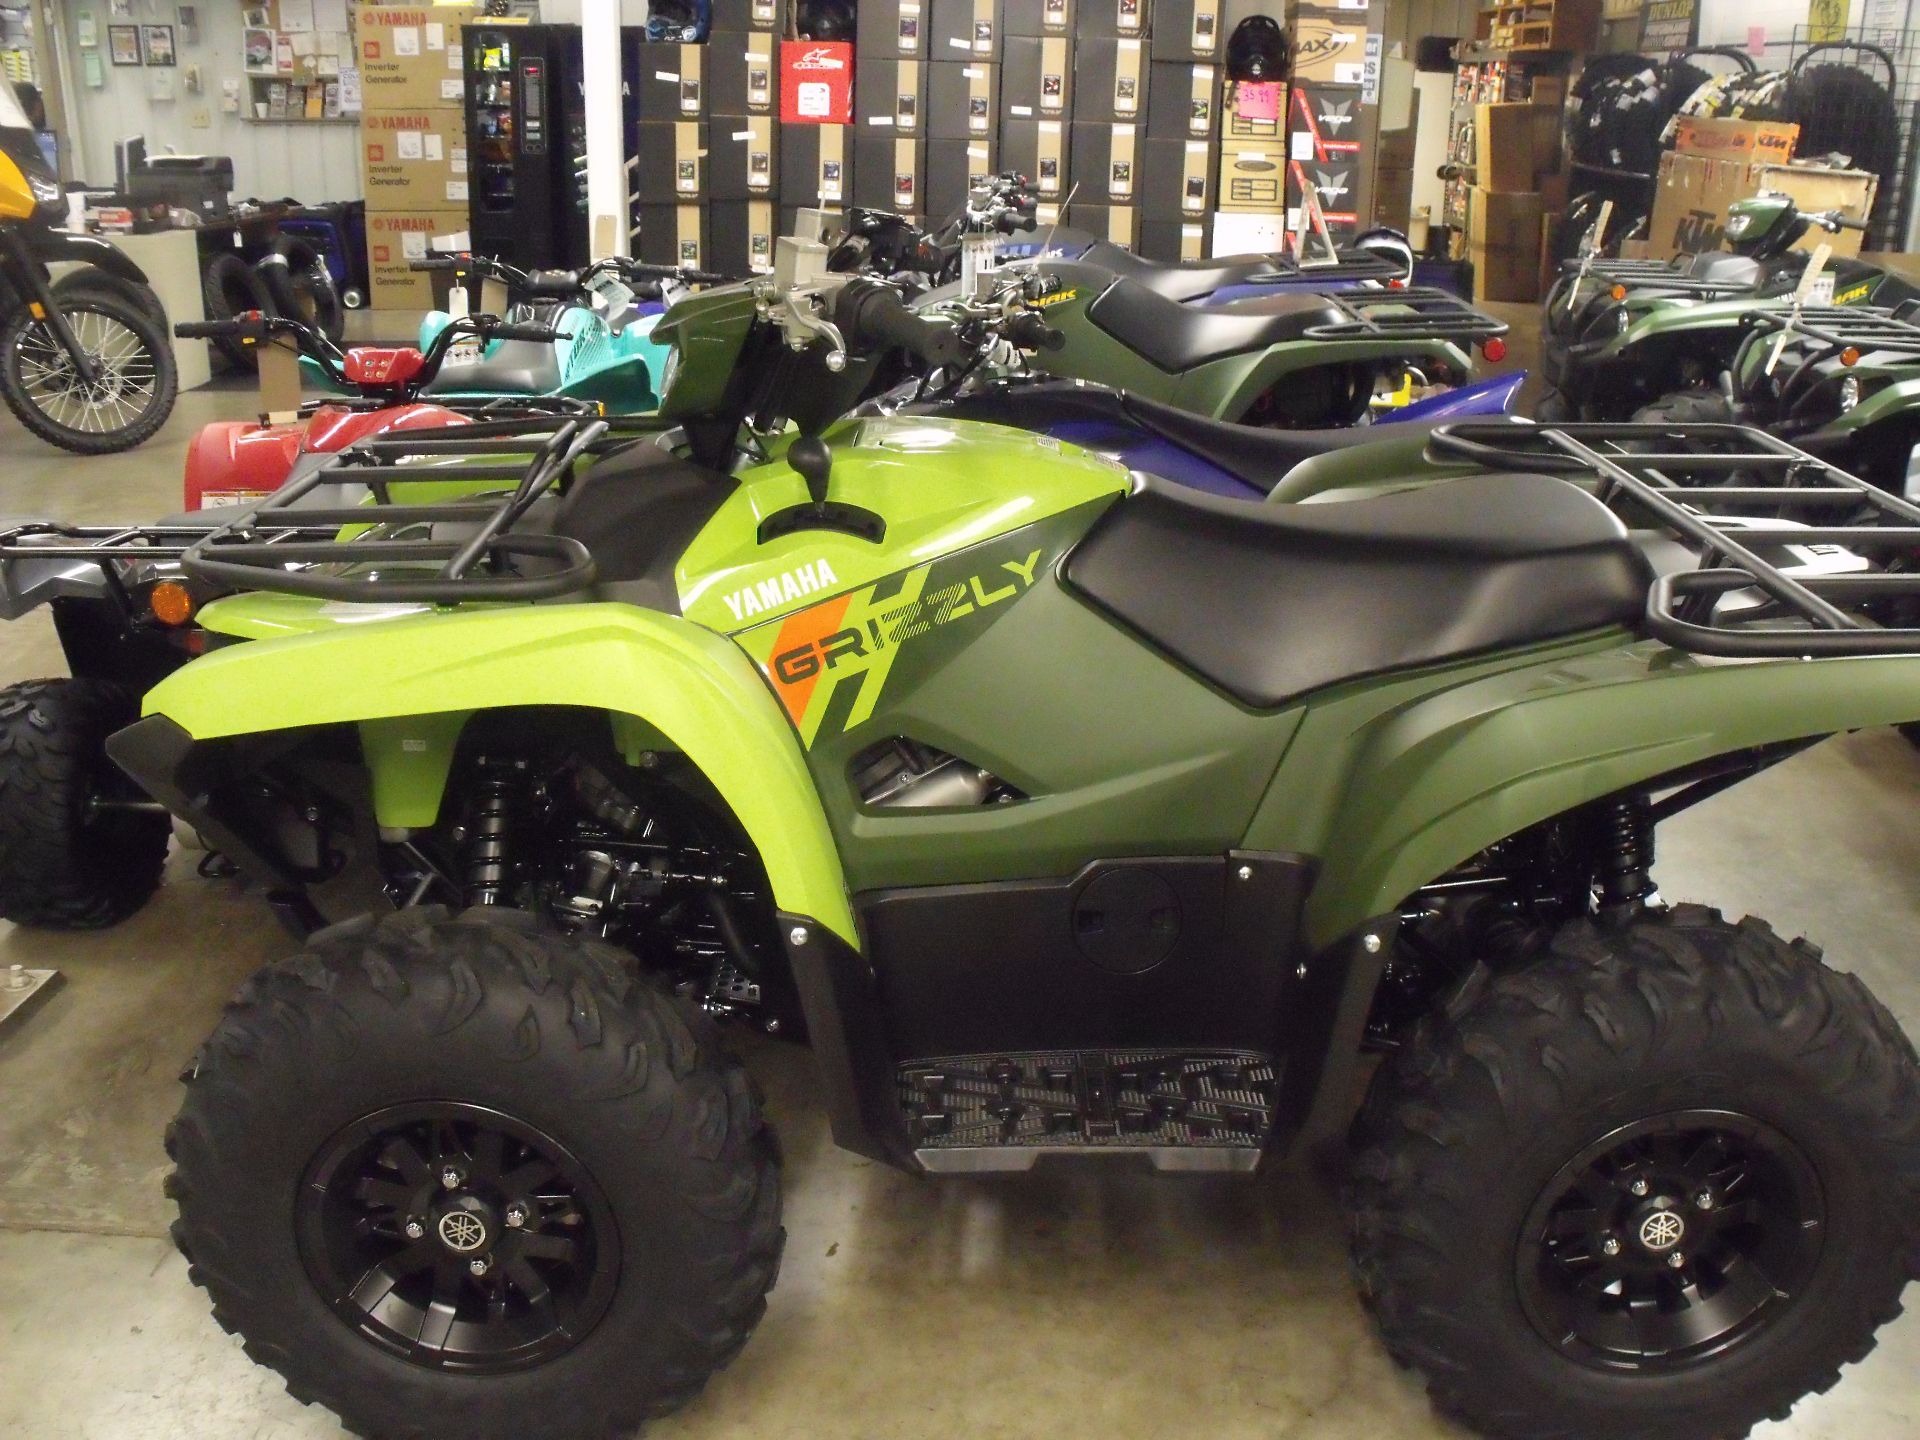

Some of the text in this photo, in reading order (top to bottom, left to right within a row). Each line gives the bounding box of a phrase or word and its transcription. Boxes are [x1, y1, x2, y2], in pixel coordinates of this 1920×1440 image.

[376, 12, 427, 26] YAMAHA
[364, 62, 400, 72] Inverter
[365, 75, 408, 84] Generator
[381, 116, 431, 130] YAMAHA
[368, 165, 402, 174] Inverter
[369, 177, 410, 186] Generator
[387, 218, 435, 231] YAMAHA
[1672, 209, 1726, 252] KTM
[374, 263, 408, 273] Inverter
[376, 277, 415, 286] Generator
[722, 559, 839, 621] YAMAHA
[774, 548, 1042, 685] GRIZZLY
